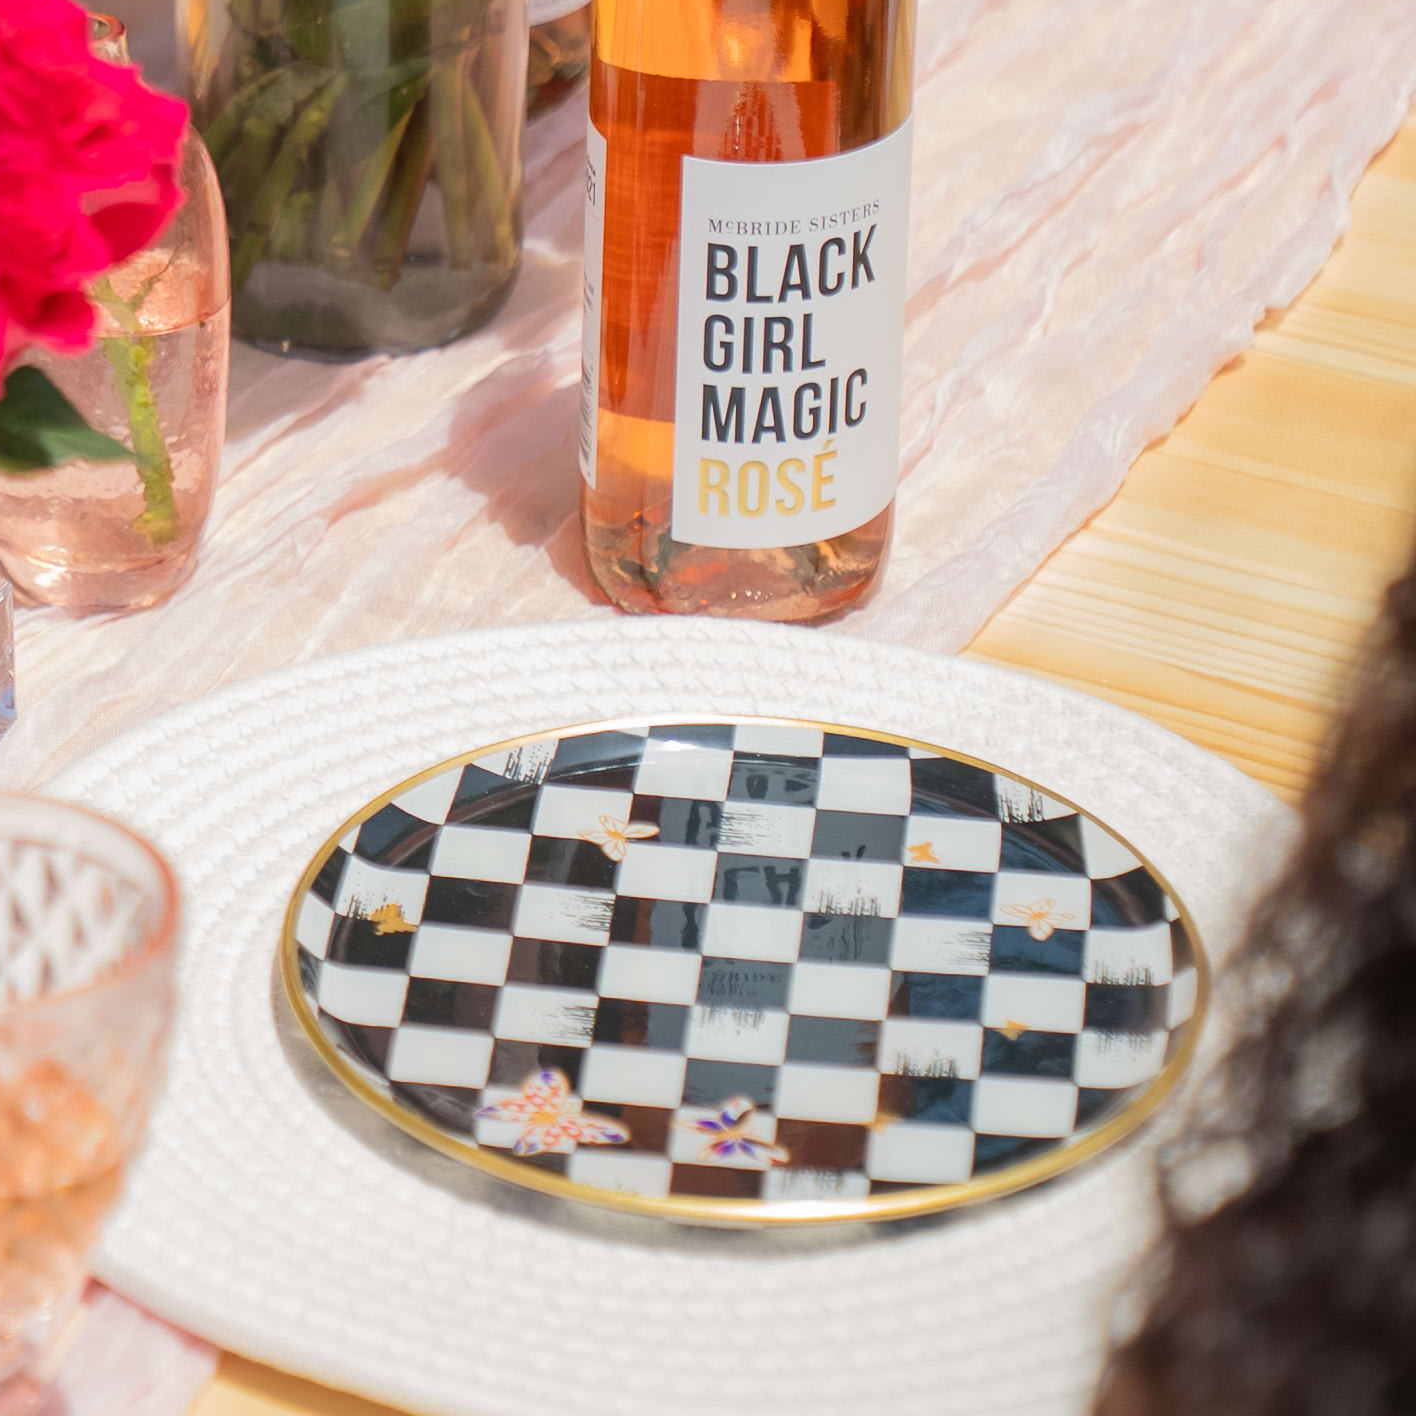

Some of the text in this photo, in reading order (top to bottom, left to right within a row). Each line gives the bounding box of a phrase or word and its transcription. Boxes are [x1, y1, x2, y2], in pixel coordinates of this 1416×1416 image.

[809, 199, 880, 232] SISTERS
[704, 224, 878, 304] BLACK
[702, 313, 826, 374] GIRL
[700, 367, 868, 444] MAGIC
[698, 439, 839, 518] ROSÉ
